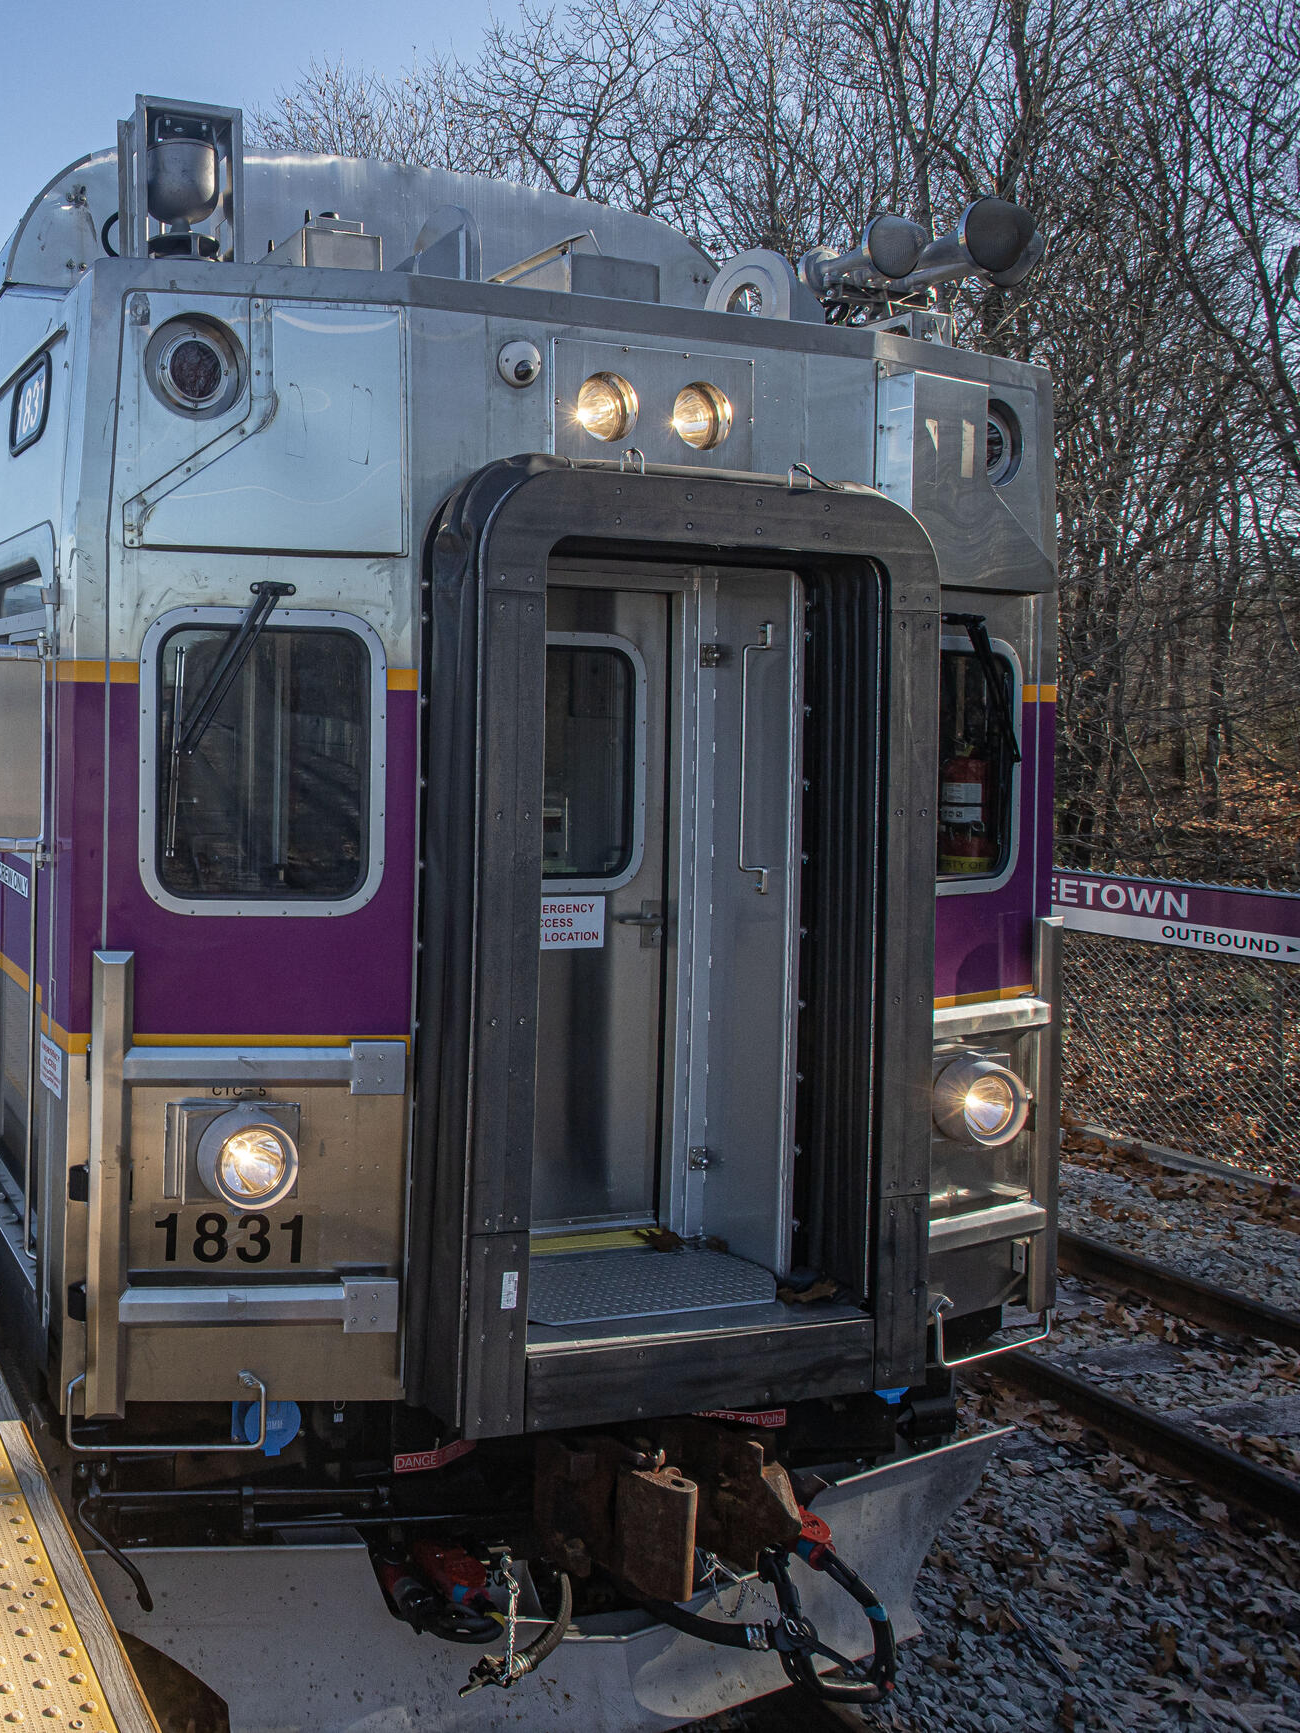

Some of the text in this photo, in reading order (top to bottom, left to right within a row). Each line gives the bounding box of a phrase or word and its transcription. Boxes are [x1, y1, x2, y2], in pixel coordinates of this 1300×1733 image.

[1051, 877, 1188, 918] ETOWN
[545, 931, 599, 942] LOCATION
[1161, 926, 1281, 954] OUTBOUND
[155, 1212, 303, 1263] 1831
[760, 1413, 784, 1425] Volts
